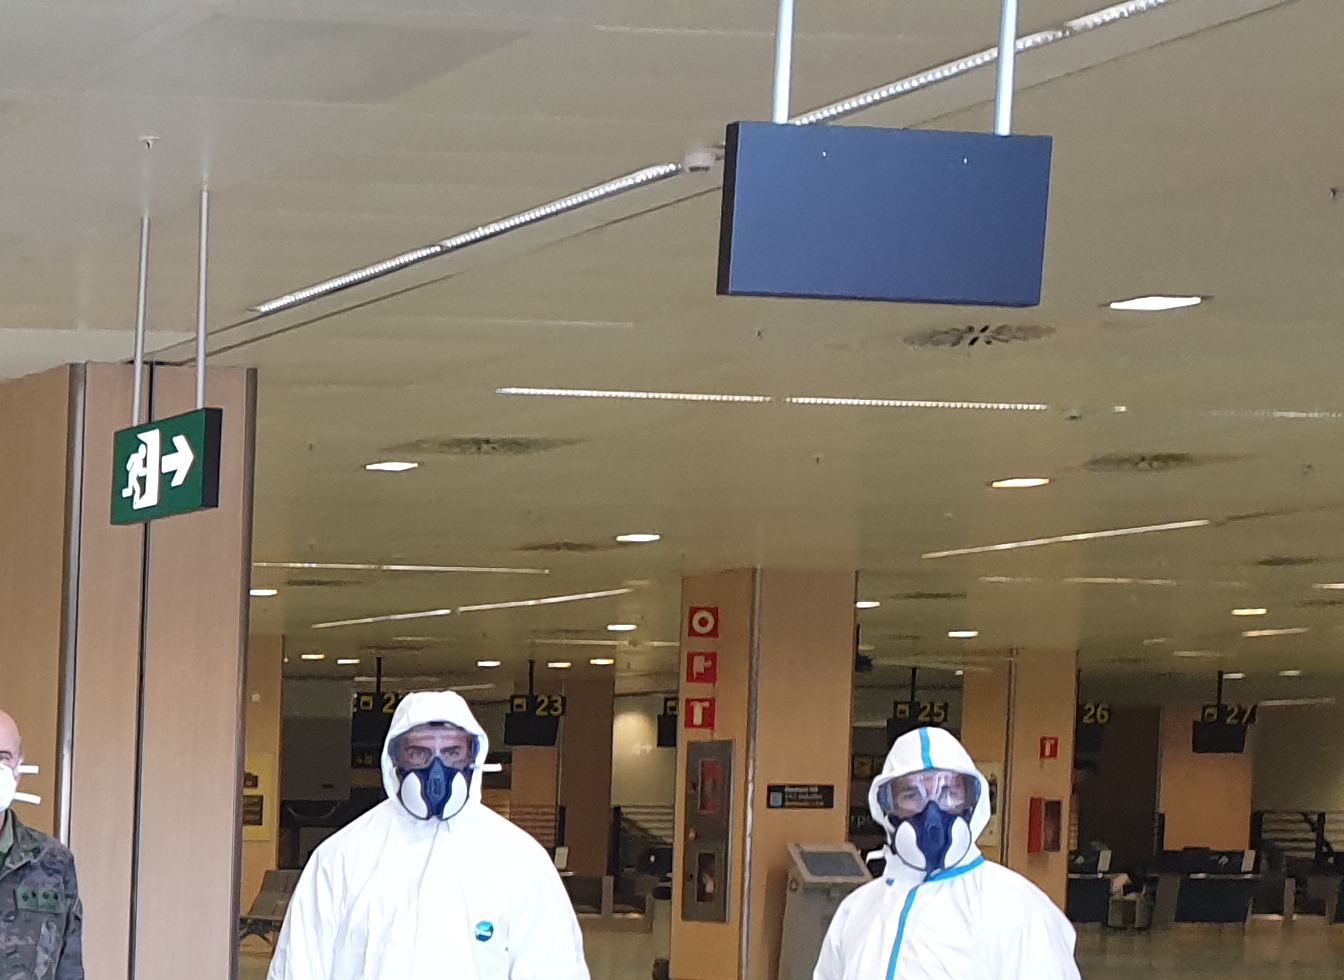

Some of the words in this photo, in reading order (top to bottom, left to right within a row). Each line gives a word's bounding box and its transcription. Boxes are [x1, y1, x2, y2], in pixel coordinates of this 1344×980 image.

[535, 694, 563, 717] 23
[917, 702, 945, 723] 25
[1082, 702, 1109, 724] 26
[1225, 705, 1255, 725] 27
